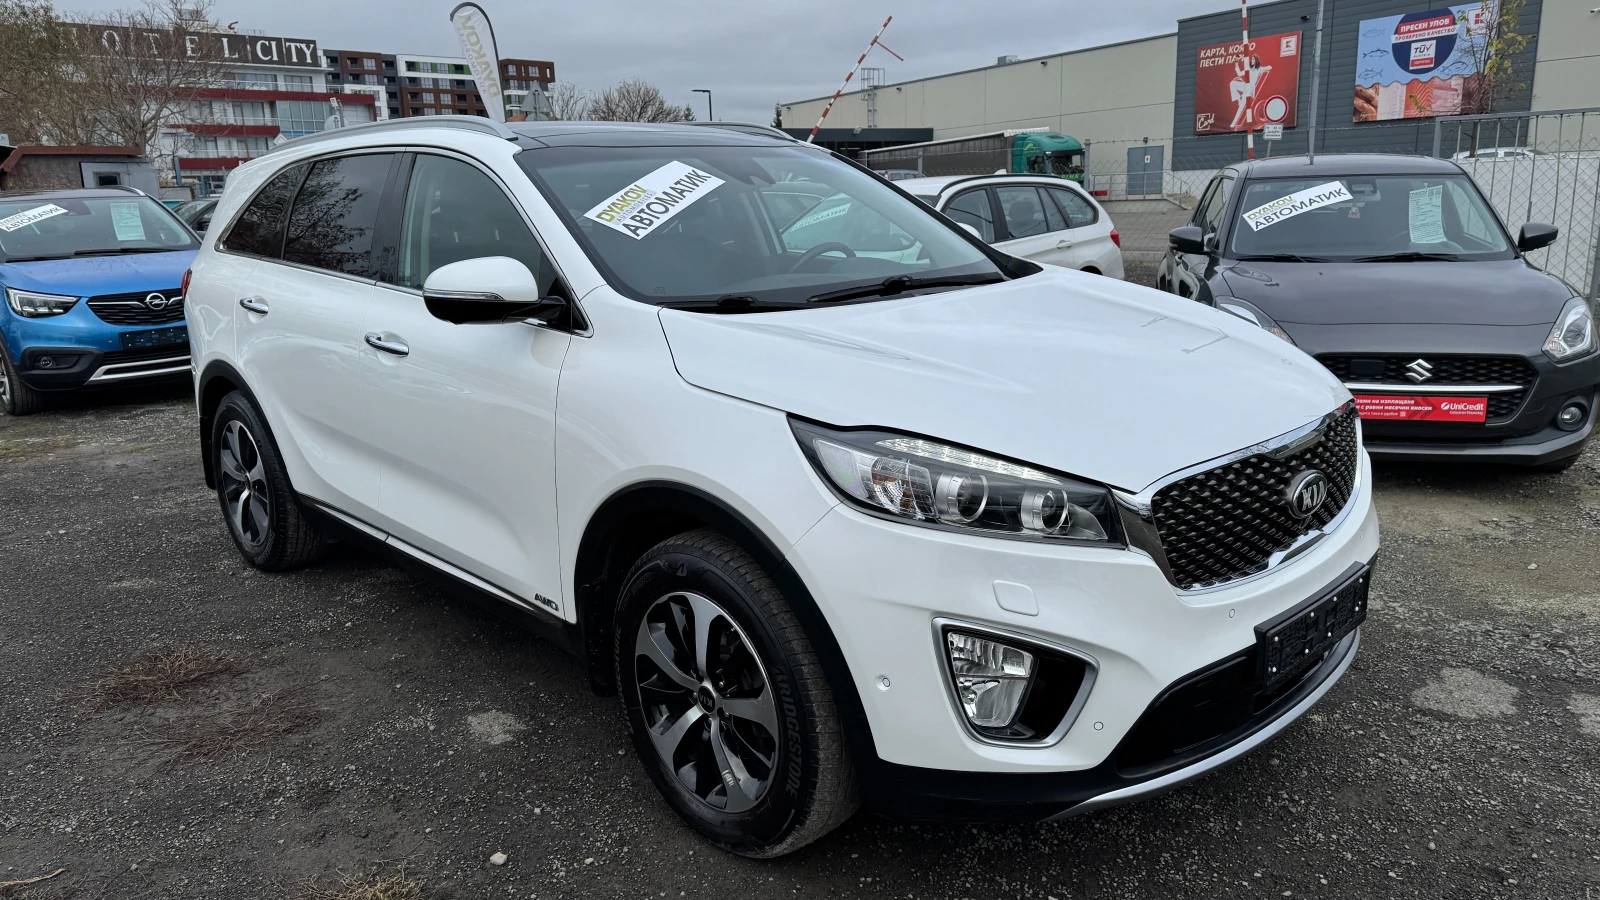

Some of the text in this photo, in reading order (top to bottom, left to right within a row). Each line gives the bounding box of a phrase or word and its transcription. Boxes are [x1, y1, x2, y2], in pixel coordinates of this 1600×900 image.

[1395, 32, 1426, 41] ПРОВЕРЕНО
[1400, 18, 1450, 33] ПРЕСЕН УЛОВ
[256, 39, 316, 63] CITY
[1199, 57, 1225, 68] ПЕСТИ
[1200, 46, 1227, 58] КАРТА,
[595, 184, 647, 223] DYAKOV
[616, 192, 653, 223] AUTOMOBILES
[621, 169, 712, 237] АВТОМАТИК
[1247, 195, 1293, 221] DYAKOV
[1254, 187, 1347, 230] АВТОМАТИК
[1450, 402, 1484, 410] UniCredit
[1301, 480, 1326, 511] KIA
[534, 592, 560, 611] AWD
